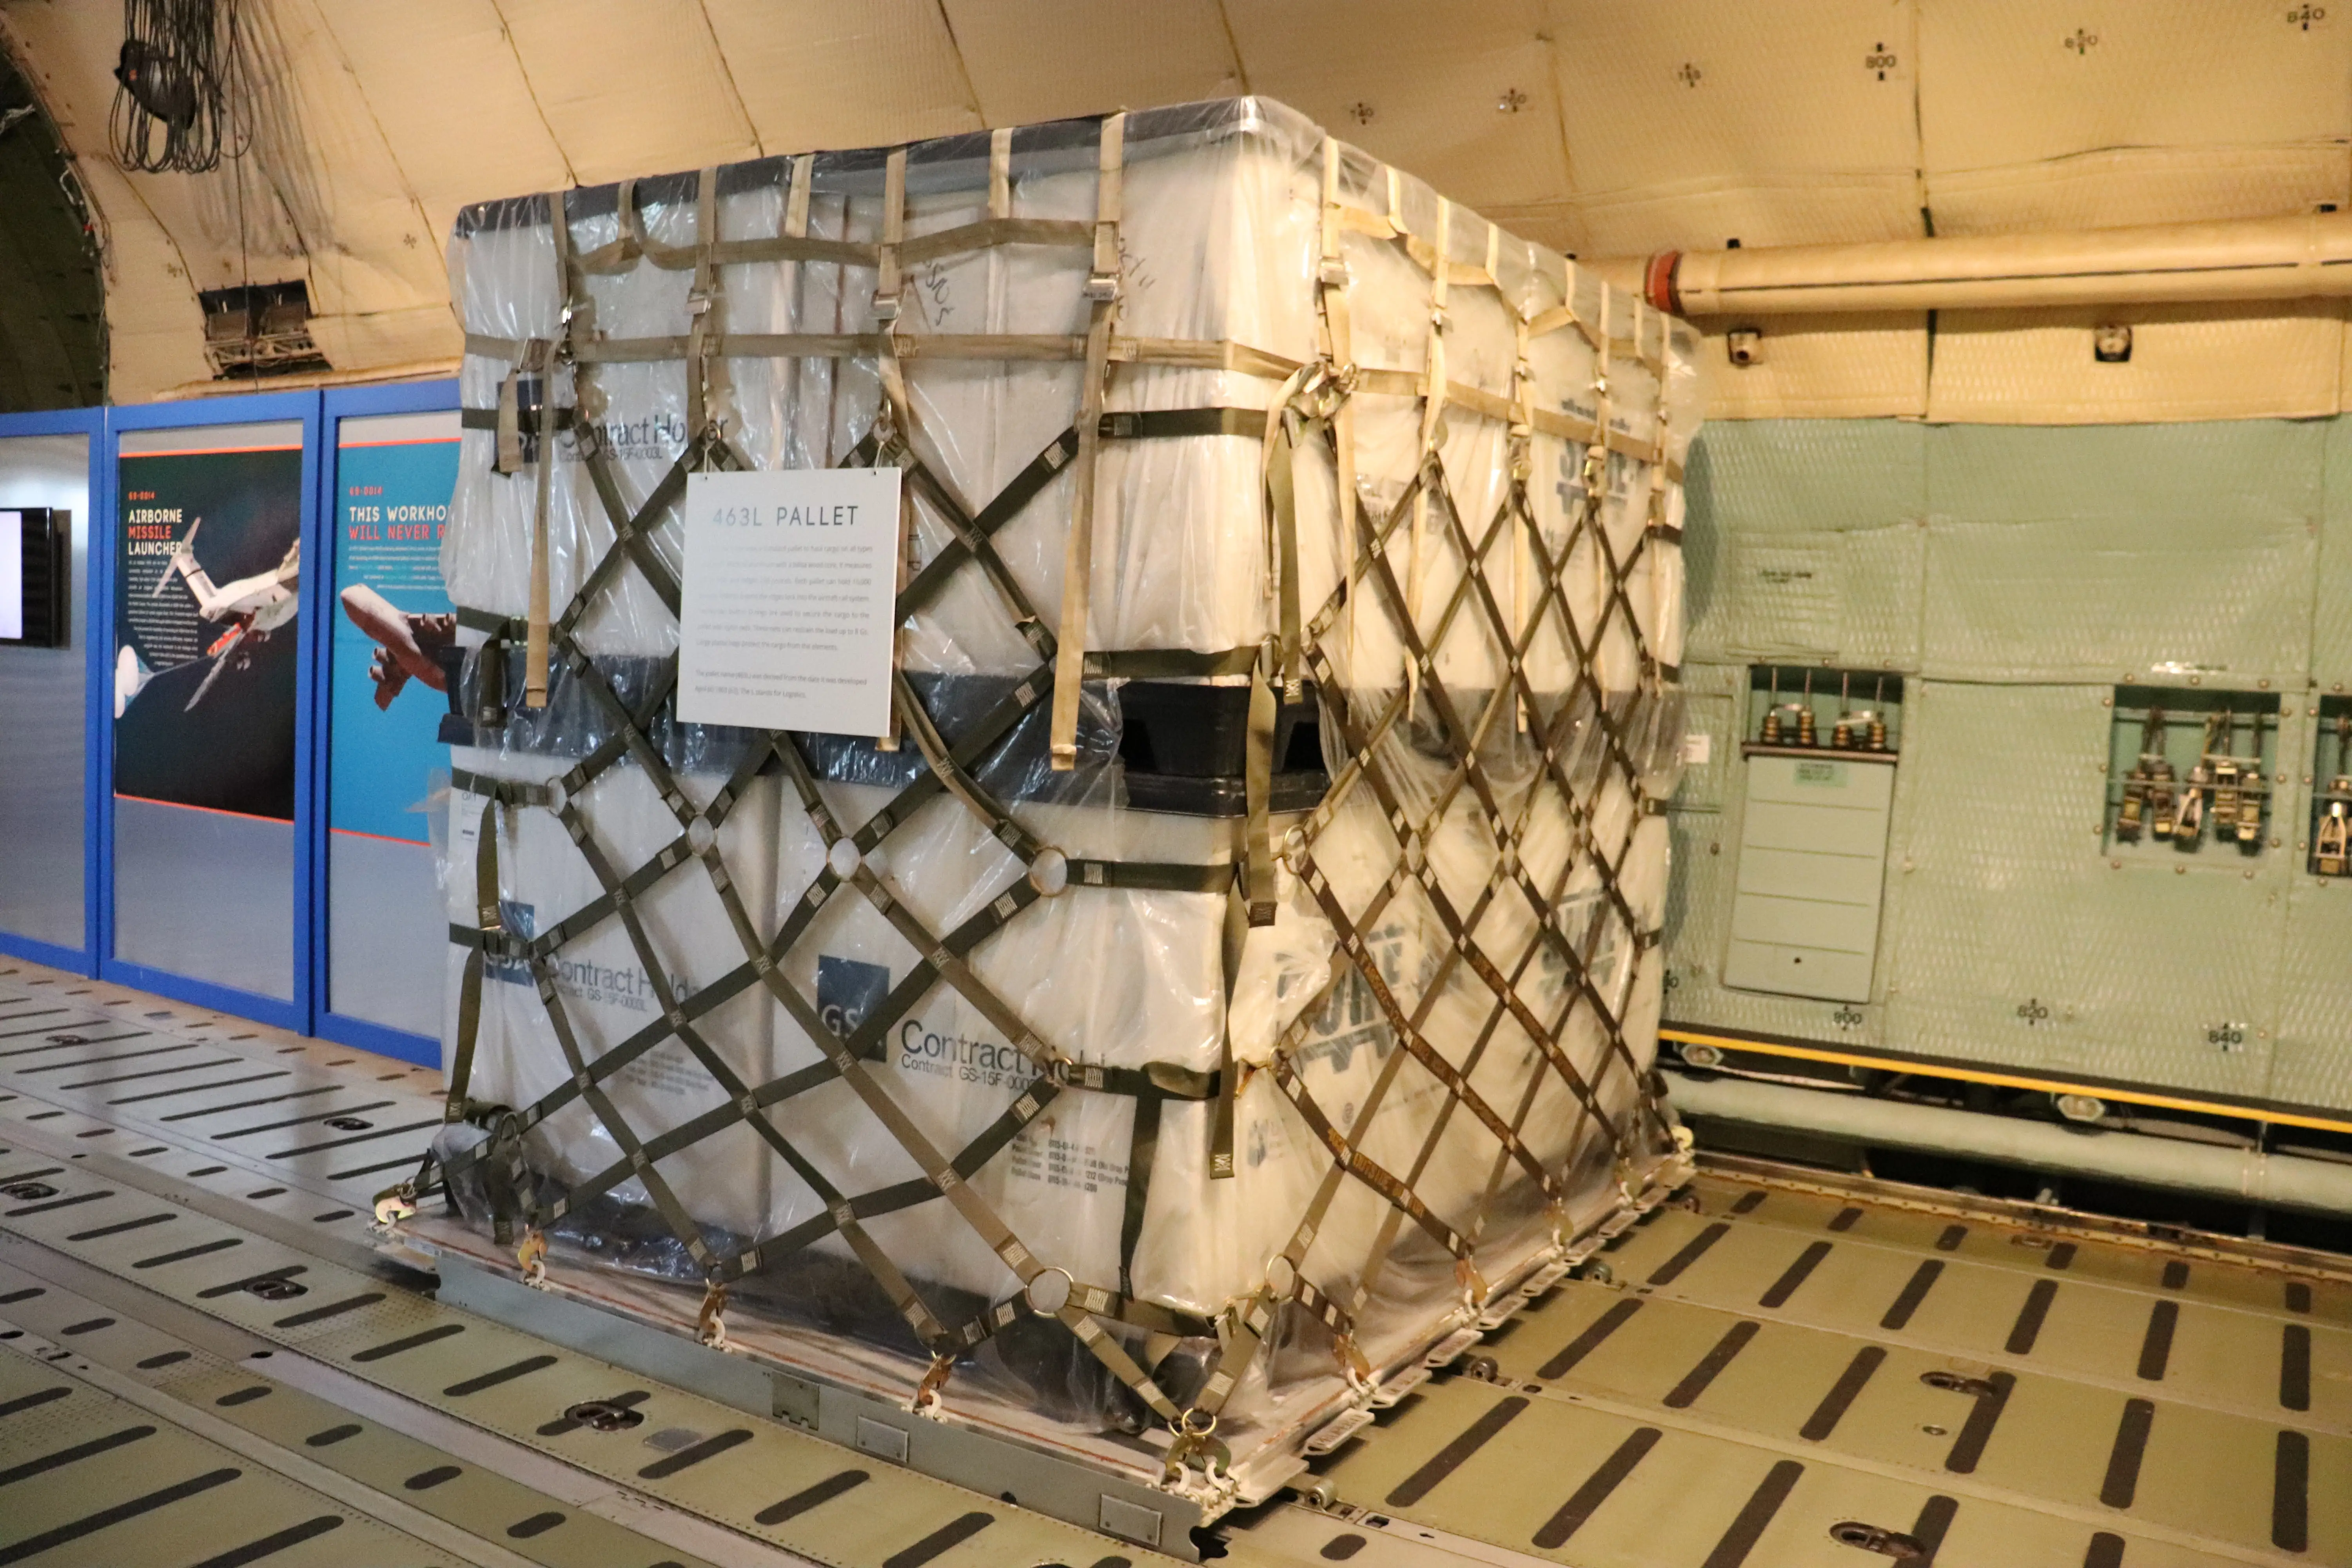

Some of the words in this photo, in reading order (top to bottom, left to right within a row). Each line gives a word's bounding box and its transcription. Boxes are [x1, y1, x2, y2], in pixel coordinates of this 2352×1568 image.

[129, 509, 182, 524] AIRBORNE
[349, 506, 380, 522] THIS
[387, 505, 448, 522] WORKHO
[713, 507, 762, 526] 463L
[776, 505, 859, 526] PALLET
[128, 525, 172, 539] MISSILE
[349, 525, 381, 540] WILL
[388, 524, 430, 540] NEVER
[128, 541, 182, 555] LAUNCHER
[857, 545, 873, 554] types
[834, 612, 850, 620] cargo
[837, 677, 867, 686] developed
[551, 953, 633, 995] ontract
[823, 1004, 862, 1040] GS
[901, 1019, 1024, 1074] Contract
[901, 1054, 953, 1078] Contract
